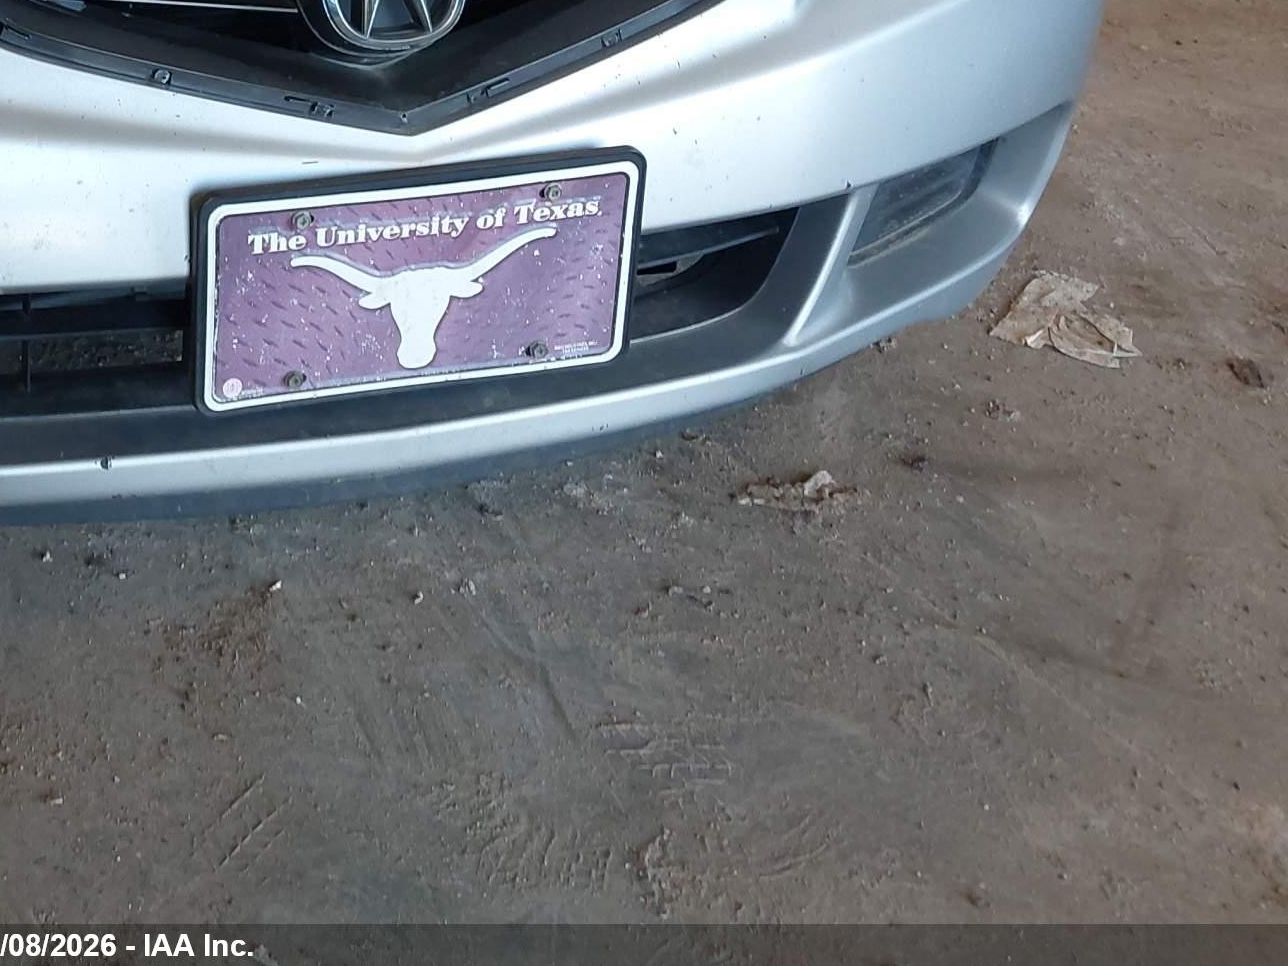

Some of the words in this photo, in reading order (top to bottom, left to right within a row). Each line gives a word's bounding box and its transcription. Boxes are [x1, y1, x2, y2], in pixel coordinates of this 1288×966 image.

[248, 233, 307, 255] The
[316, 214, 470, 247] University
[476, 207, 507, 230] of
